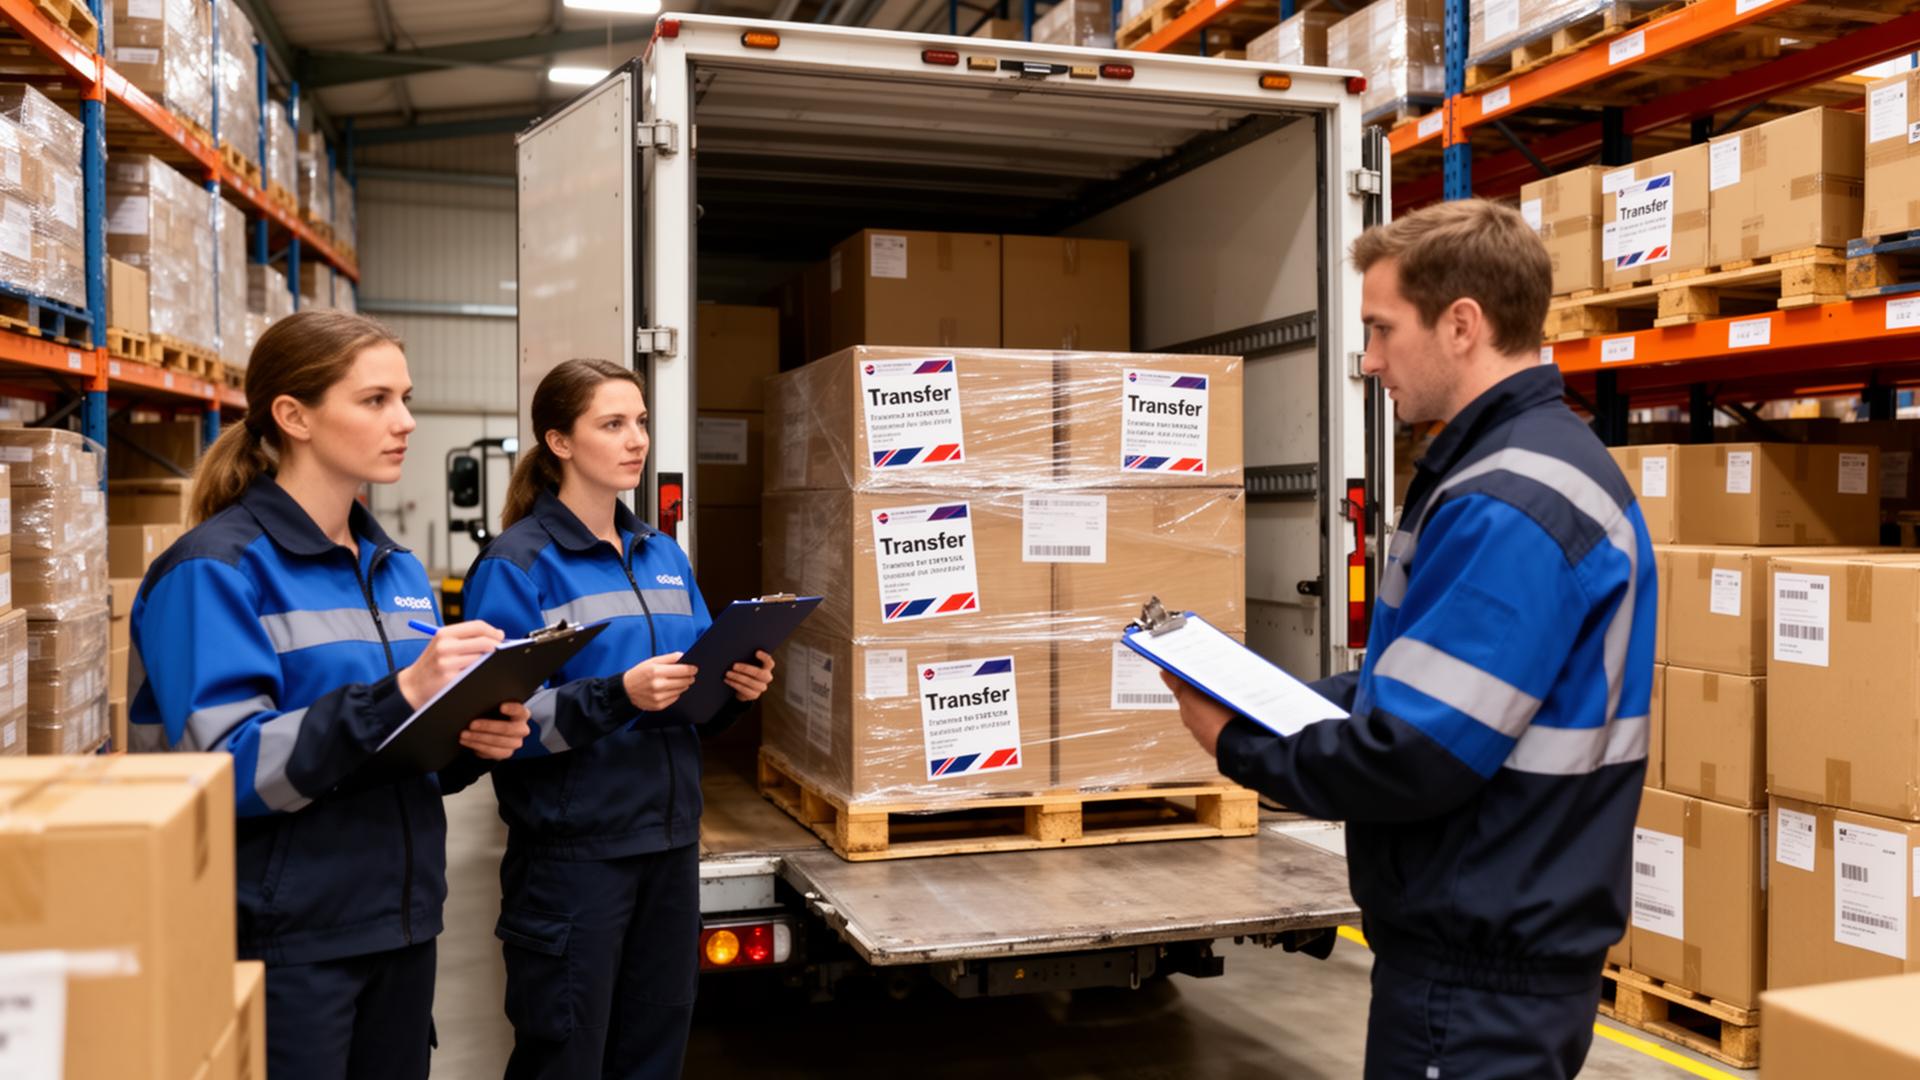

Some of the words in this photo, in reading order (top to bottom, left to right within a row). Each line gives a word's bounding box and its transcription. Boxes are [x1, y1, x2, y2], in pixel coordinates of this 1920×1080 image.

[1620, 199, 1668, 220] Transfer
[868, 385, 952, 407] Transfer
[1128, 394, 1203, 417] Transfer
[880, 531, 966, 556] Transfer
[925, 687, 1010, 711] Transfer
